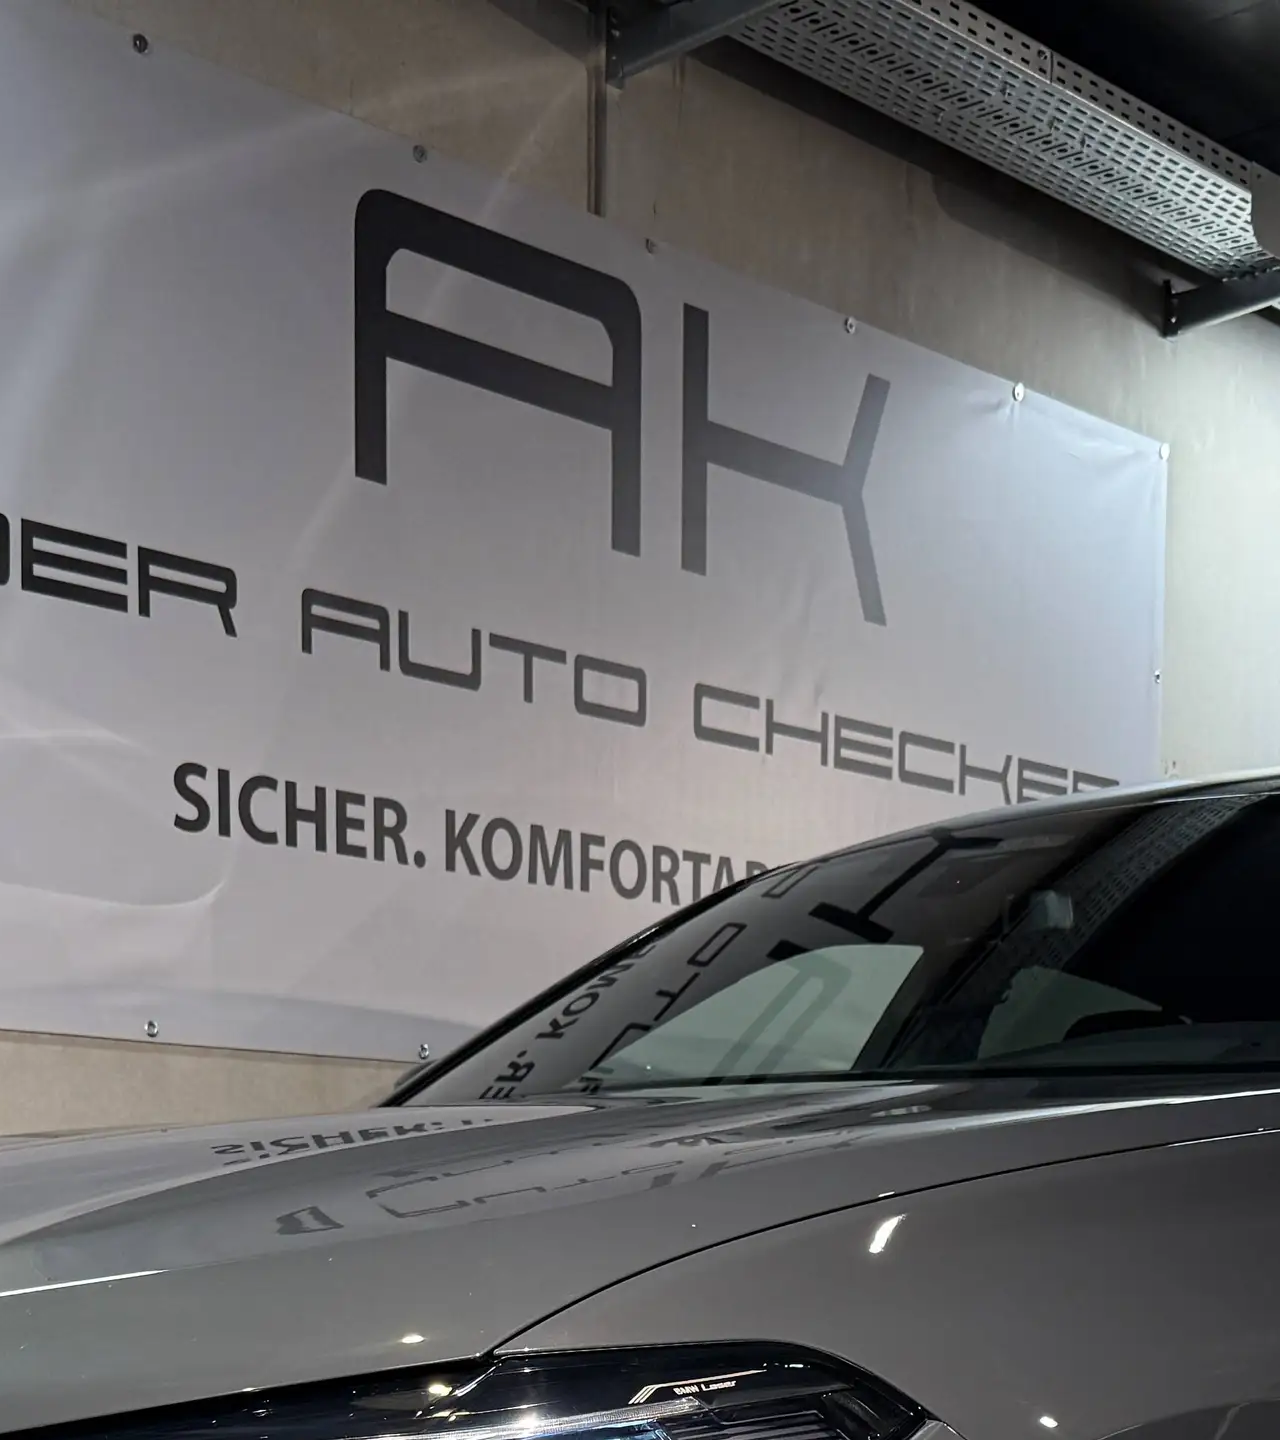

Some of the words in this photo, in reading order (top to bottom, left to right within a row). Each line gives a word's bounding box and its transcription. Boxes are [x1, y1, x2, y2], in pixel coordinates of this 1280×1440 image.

[353, 188, 892, 628] AK
[301, 587, 649, 729] AUTO
[171, 762, 427, 871] SICHER.
[672, 1384, 700, 1396] BMW
